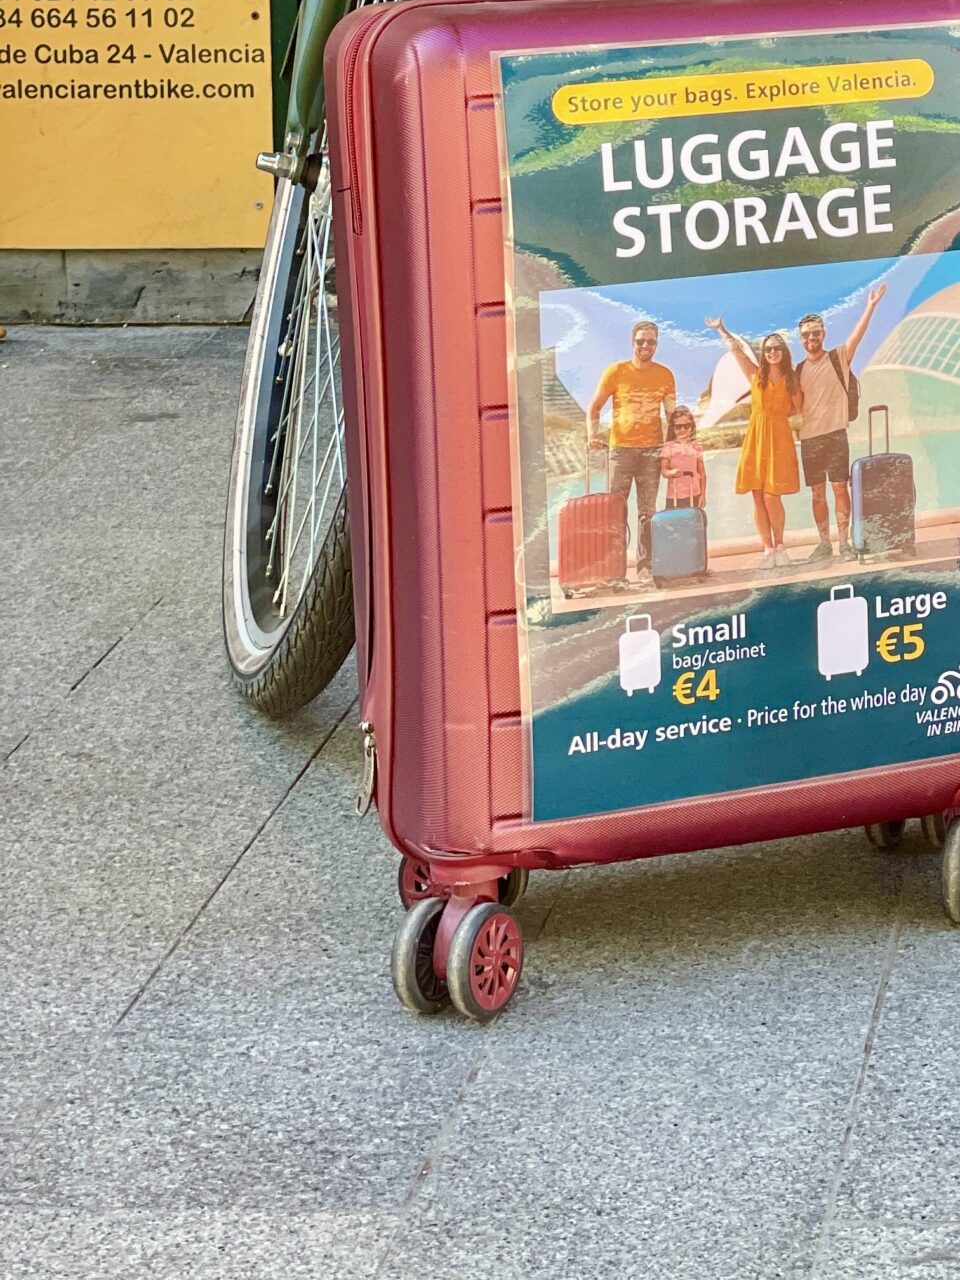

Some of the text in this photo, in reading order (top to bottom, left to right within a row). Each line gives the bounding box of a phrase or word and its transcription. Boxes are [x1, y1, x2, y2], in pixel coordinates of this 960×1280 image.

[30, 7, 78, 29] 664
[85, 7, 117, 29] 56
[125, 7, 153, 29] 11
[163, 7, 196, 28] 02
[34, 43, 100, 65] Cuba
[106, 43, 137, 64] 24
[158, 43, 266, 64] Valencia
[0, 78, 255, 100] alenciarentbike.com
[567, 70, 918, 114] Store your bags. Explore Valencia.
[599, 118, 899, 194] LUGGAGE
[610, 183, 896, 260] STORAGE
[873, 590, 948, 621] Large
[671, 613, 748, 649] Small
[875, 622, 926, 664] €5
[671, 641, 767, 671] bag/cabinet
[671, 667, 721, 706] €4
[566, 726, 649, 756] All-day
[655, 715, 733, 743] service
[746, 705, 789, 728] Price
[792, 698, 819, 722] for
[820, 696, 848, 718] the
[849, 689, 897, 714] whole
[899, 683, 928, 709] day
[926, 721, 943, 738] IN
